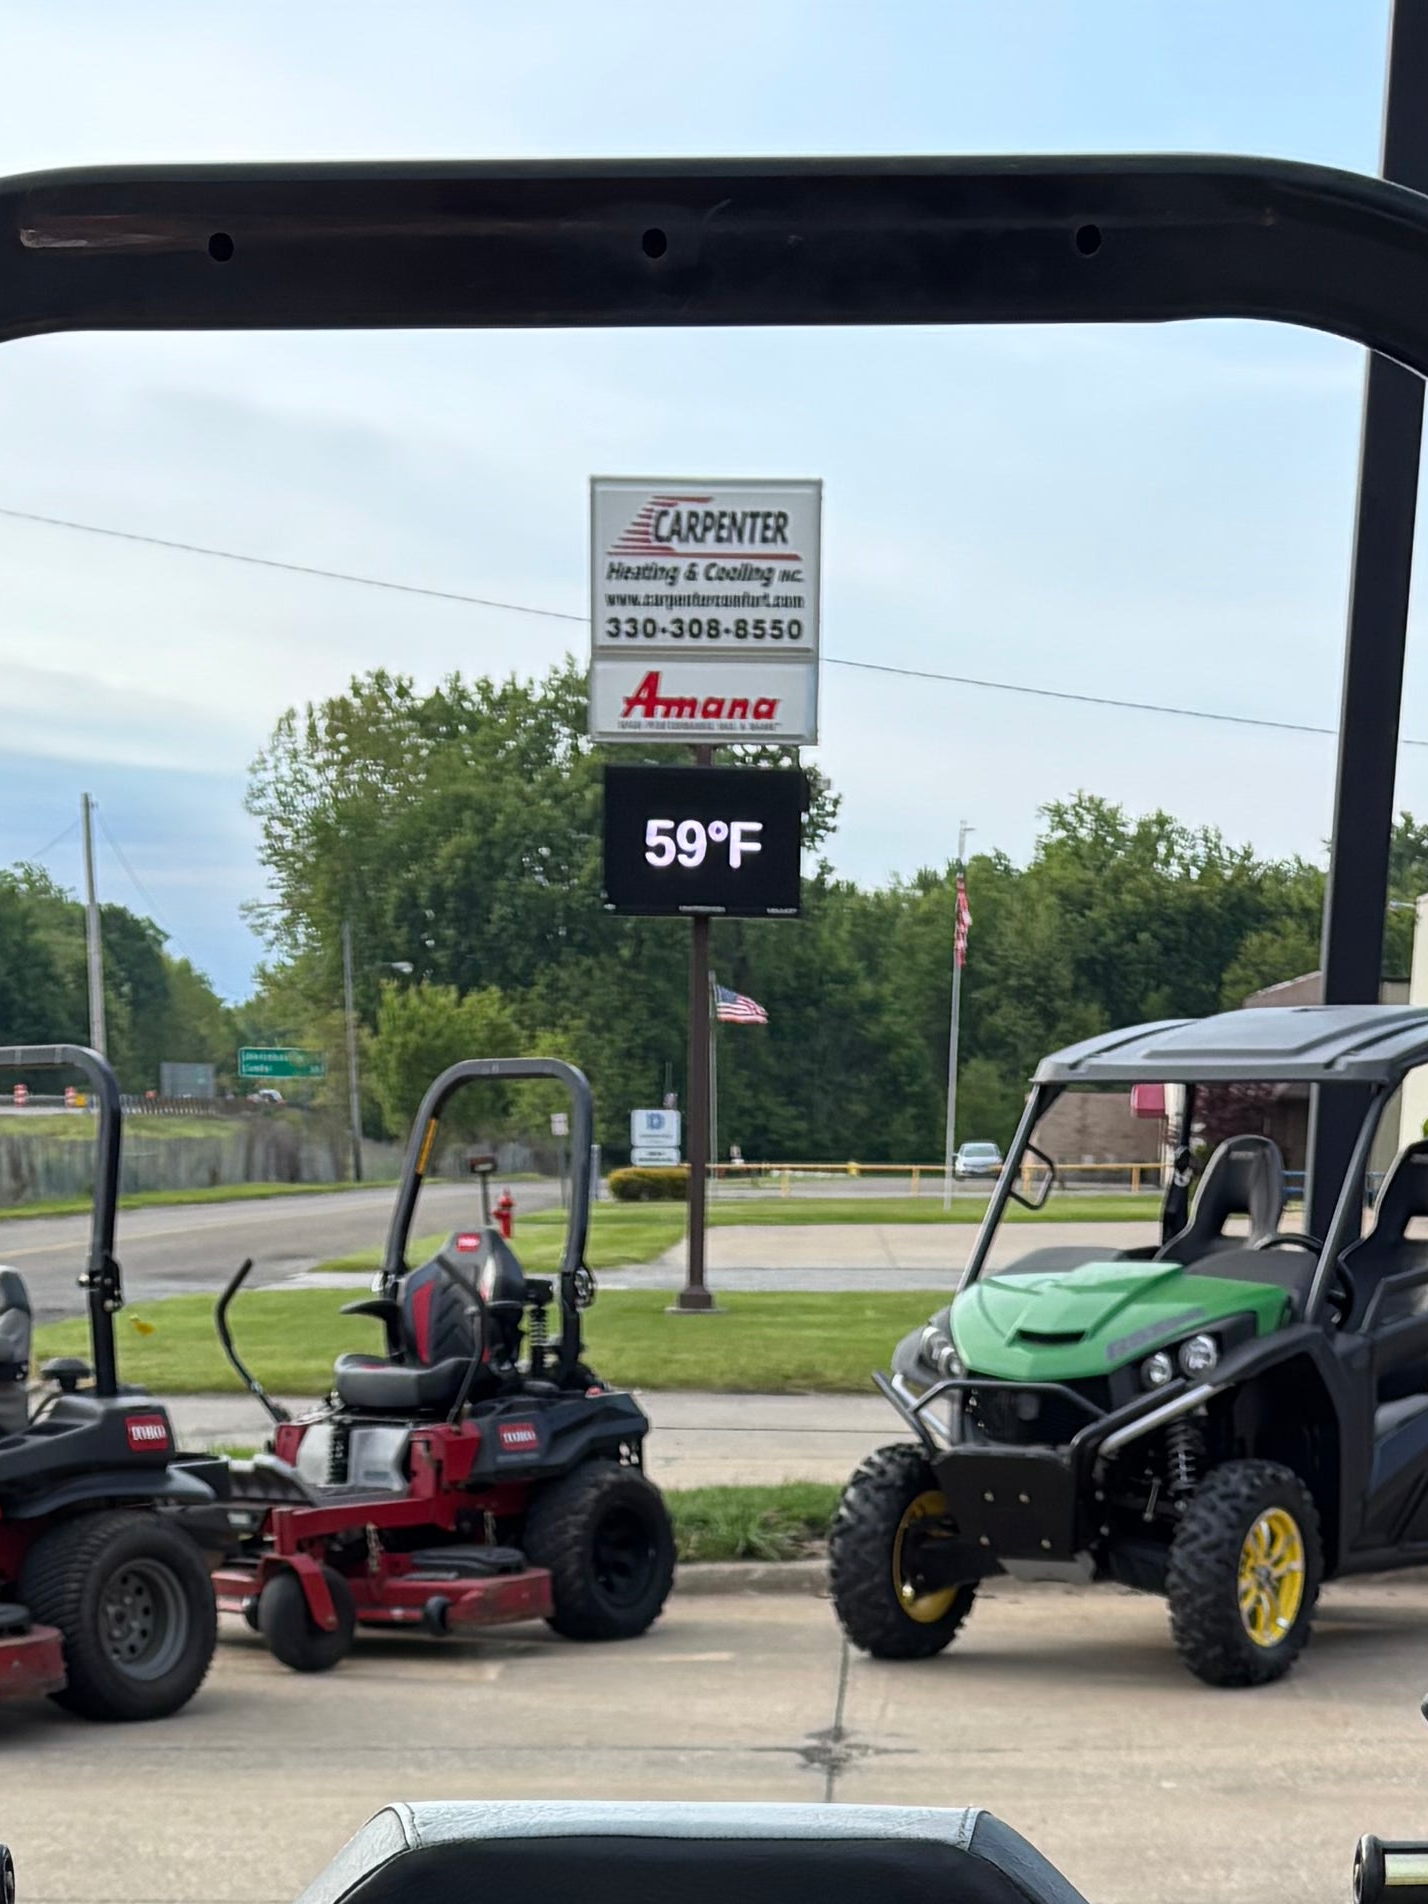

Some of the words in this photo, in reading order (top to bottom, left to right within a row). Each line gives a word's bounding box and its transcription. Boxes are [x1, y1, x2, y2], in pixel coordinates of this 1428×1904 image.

[653, 509, 789, 544] CARPENTER
[605, 562, 680, 586] Heating
[684, 562, 698, 582] &
[704, 562, 776, 587] Cooling
[620, 671, 779, 719] Amana
[645, 819, 763, 869] 59°F
